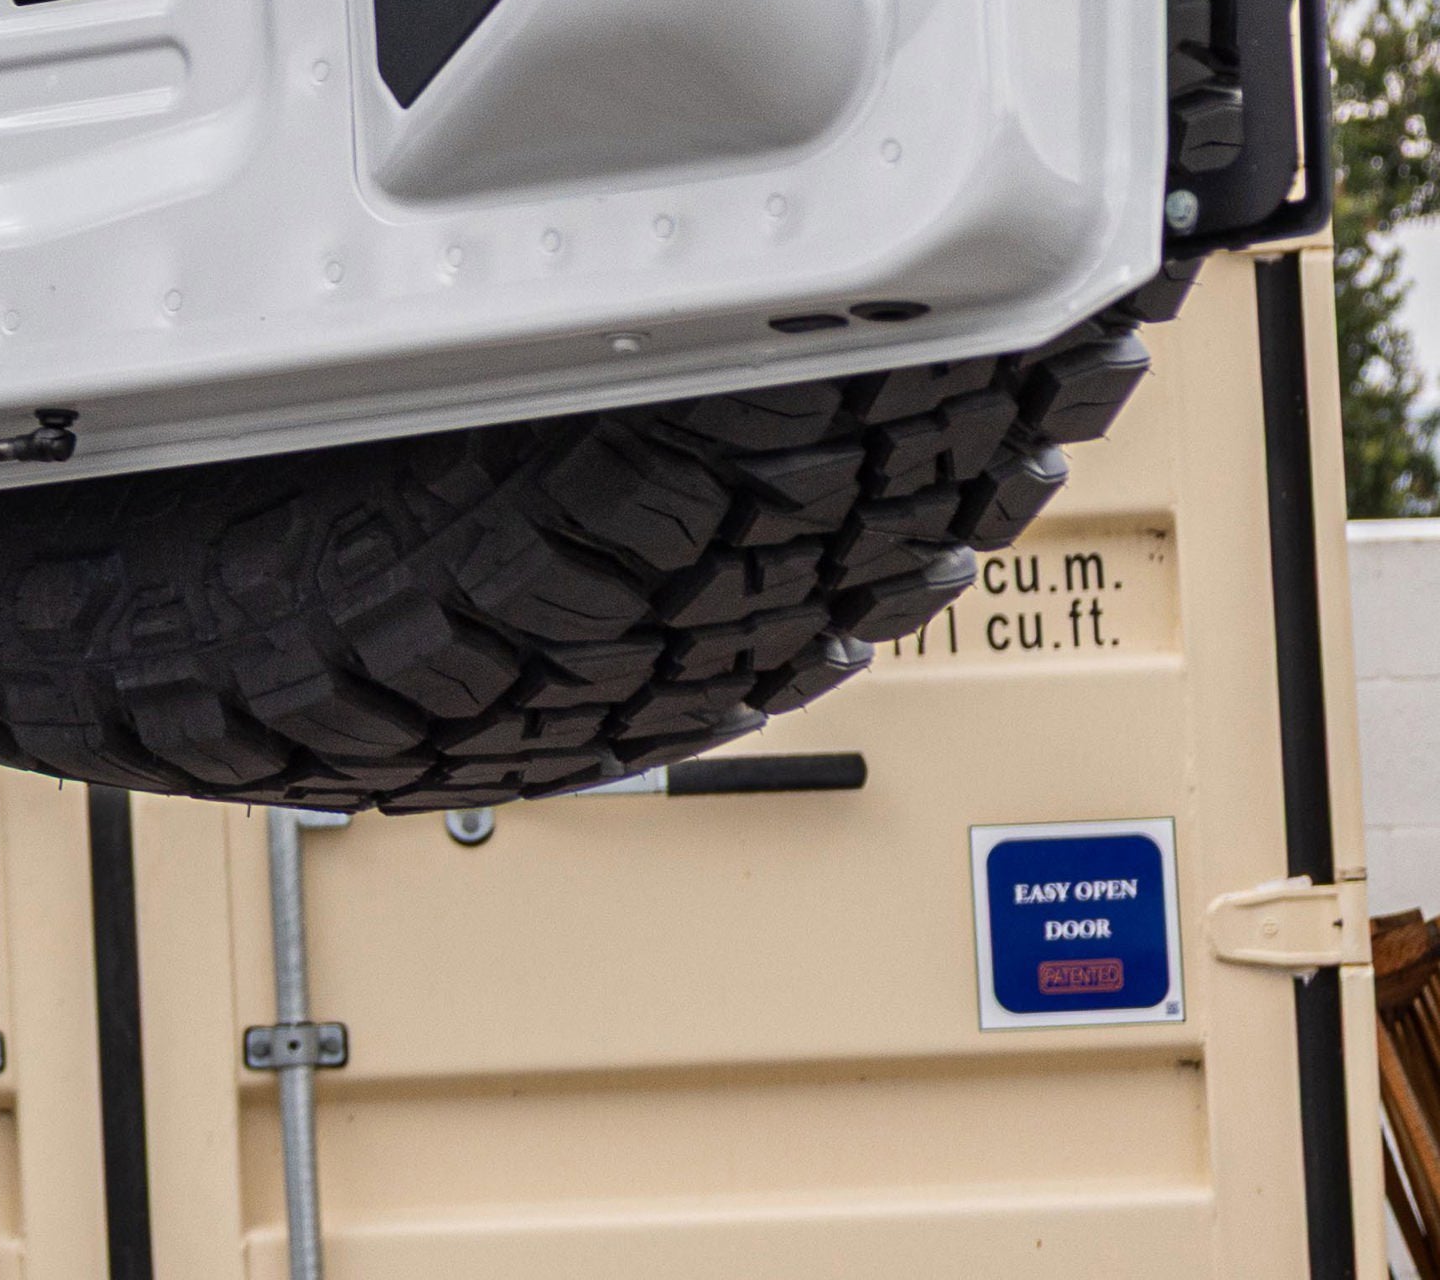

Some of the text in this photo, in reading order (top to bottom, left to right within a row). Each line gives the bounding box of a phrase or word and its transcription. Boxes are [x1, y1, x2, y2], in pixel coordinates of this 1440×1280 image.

[983, 552, 1122, 594] cu.m.
[986, 597, 1120, 651] cu.ft.
[1013, 878, 1138, 905] EASY OPEN
[1044, 918, 1112, 941] DOOR
[1044, 963, 1120, 988] PATENTED
